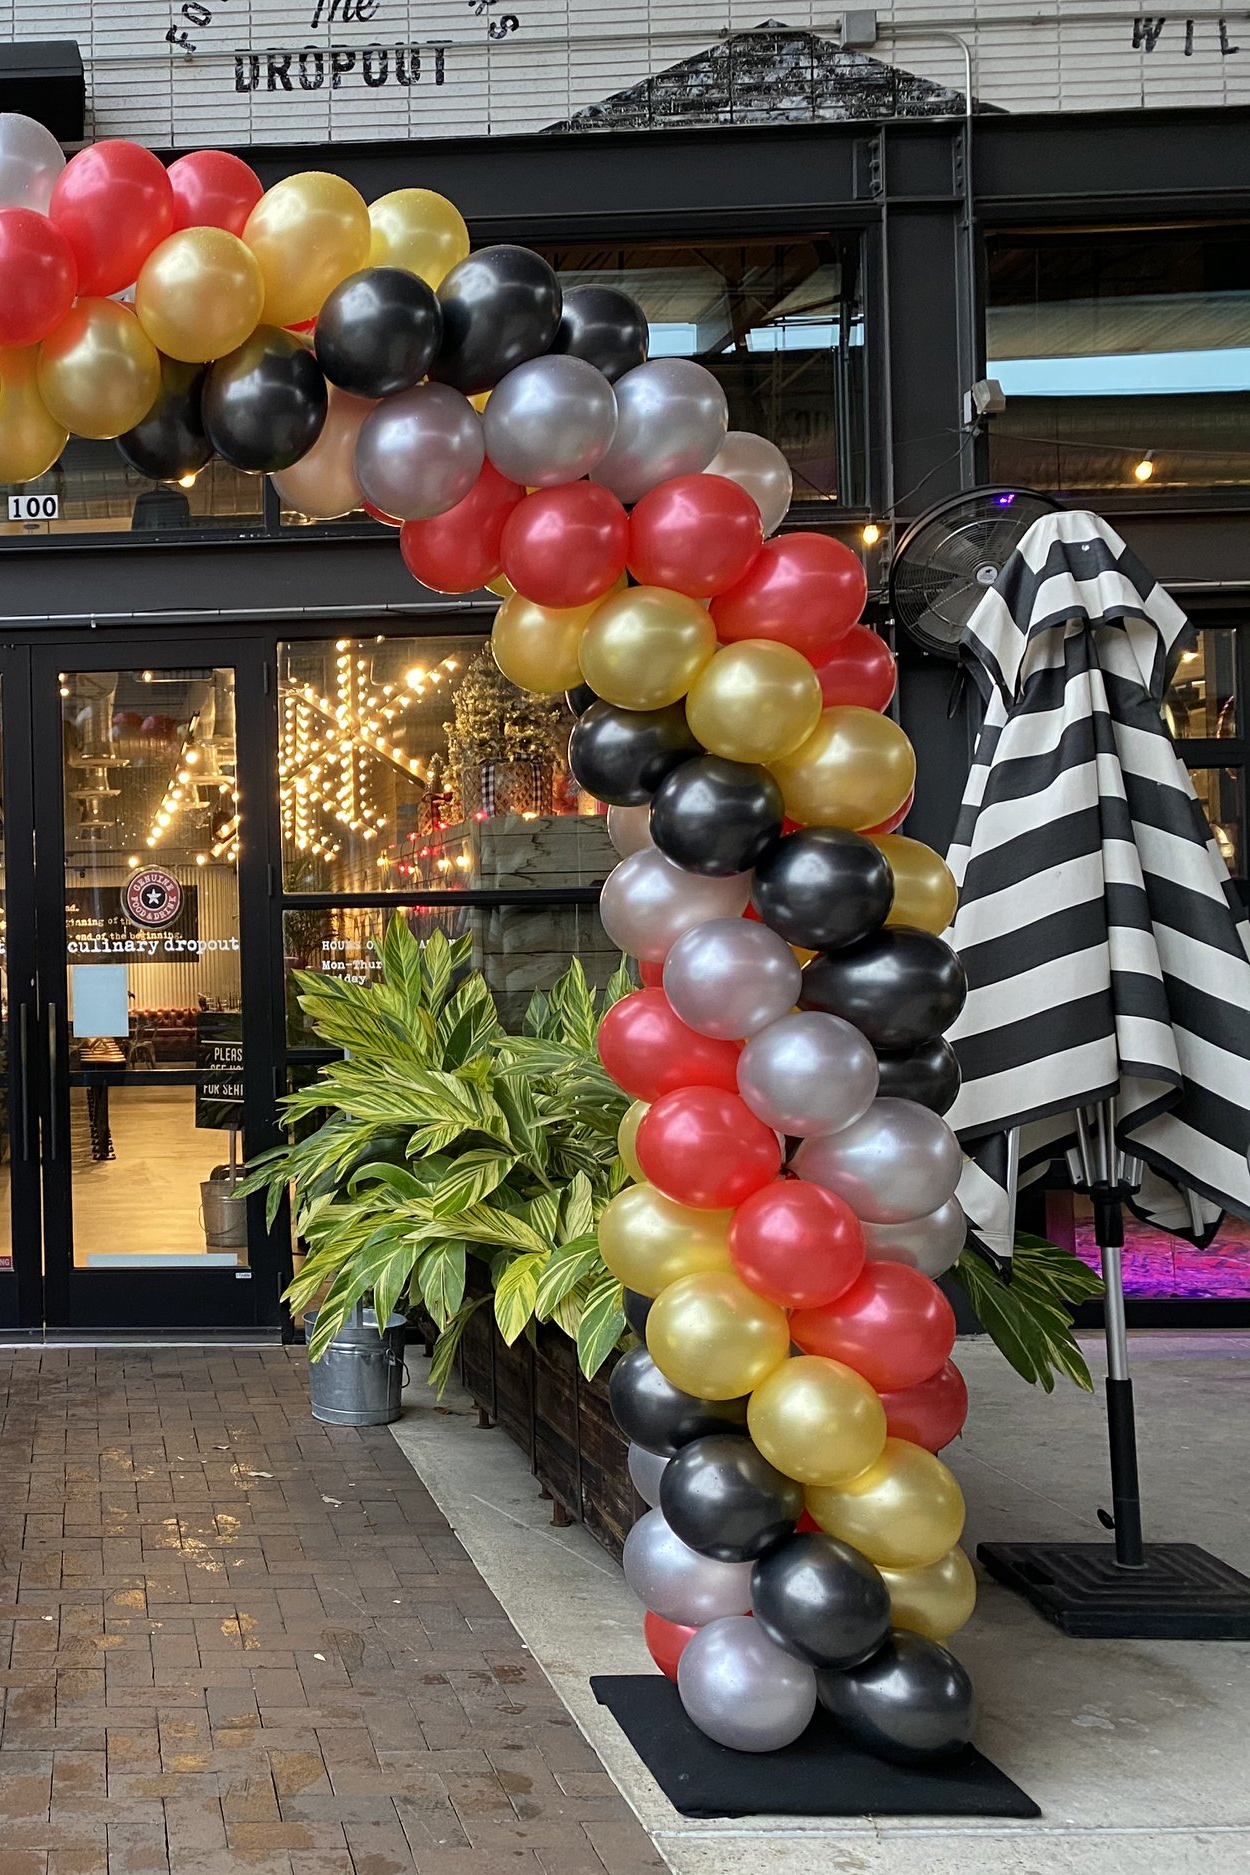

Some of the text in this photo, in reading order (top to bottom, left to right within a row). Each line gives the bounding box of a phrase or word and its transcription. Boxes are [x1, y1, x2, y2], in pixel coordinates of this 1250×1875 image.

[234, 40, 453, 93] DROPOUT
[13, 497, 57, 518] 100
[133, 873, 174, 892] GENUINE
[65, 904, 80, 912] nd.
[131, 896, 147, 917] FOOD
[153, 896, 177, 920] DRINK
[120, 916, 132, 926] th
[67, 936, 240, 955] culinary dropout
[214, 1047, 243, 1061] PLEAS
